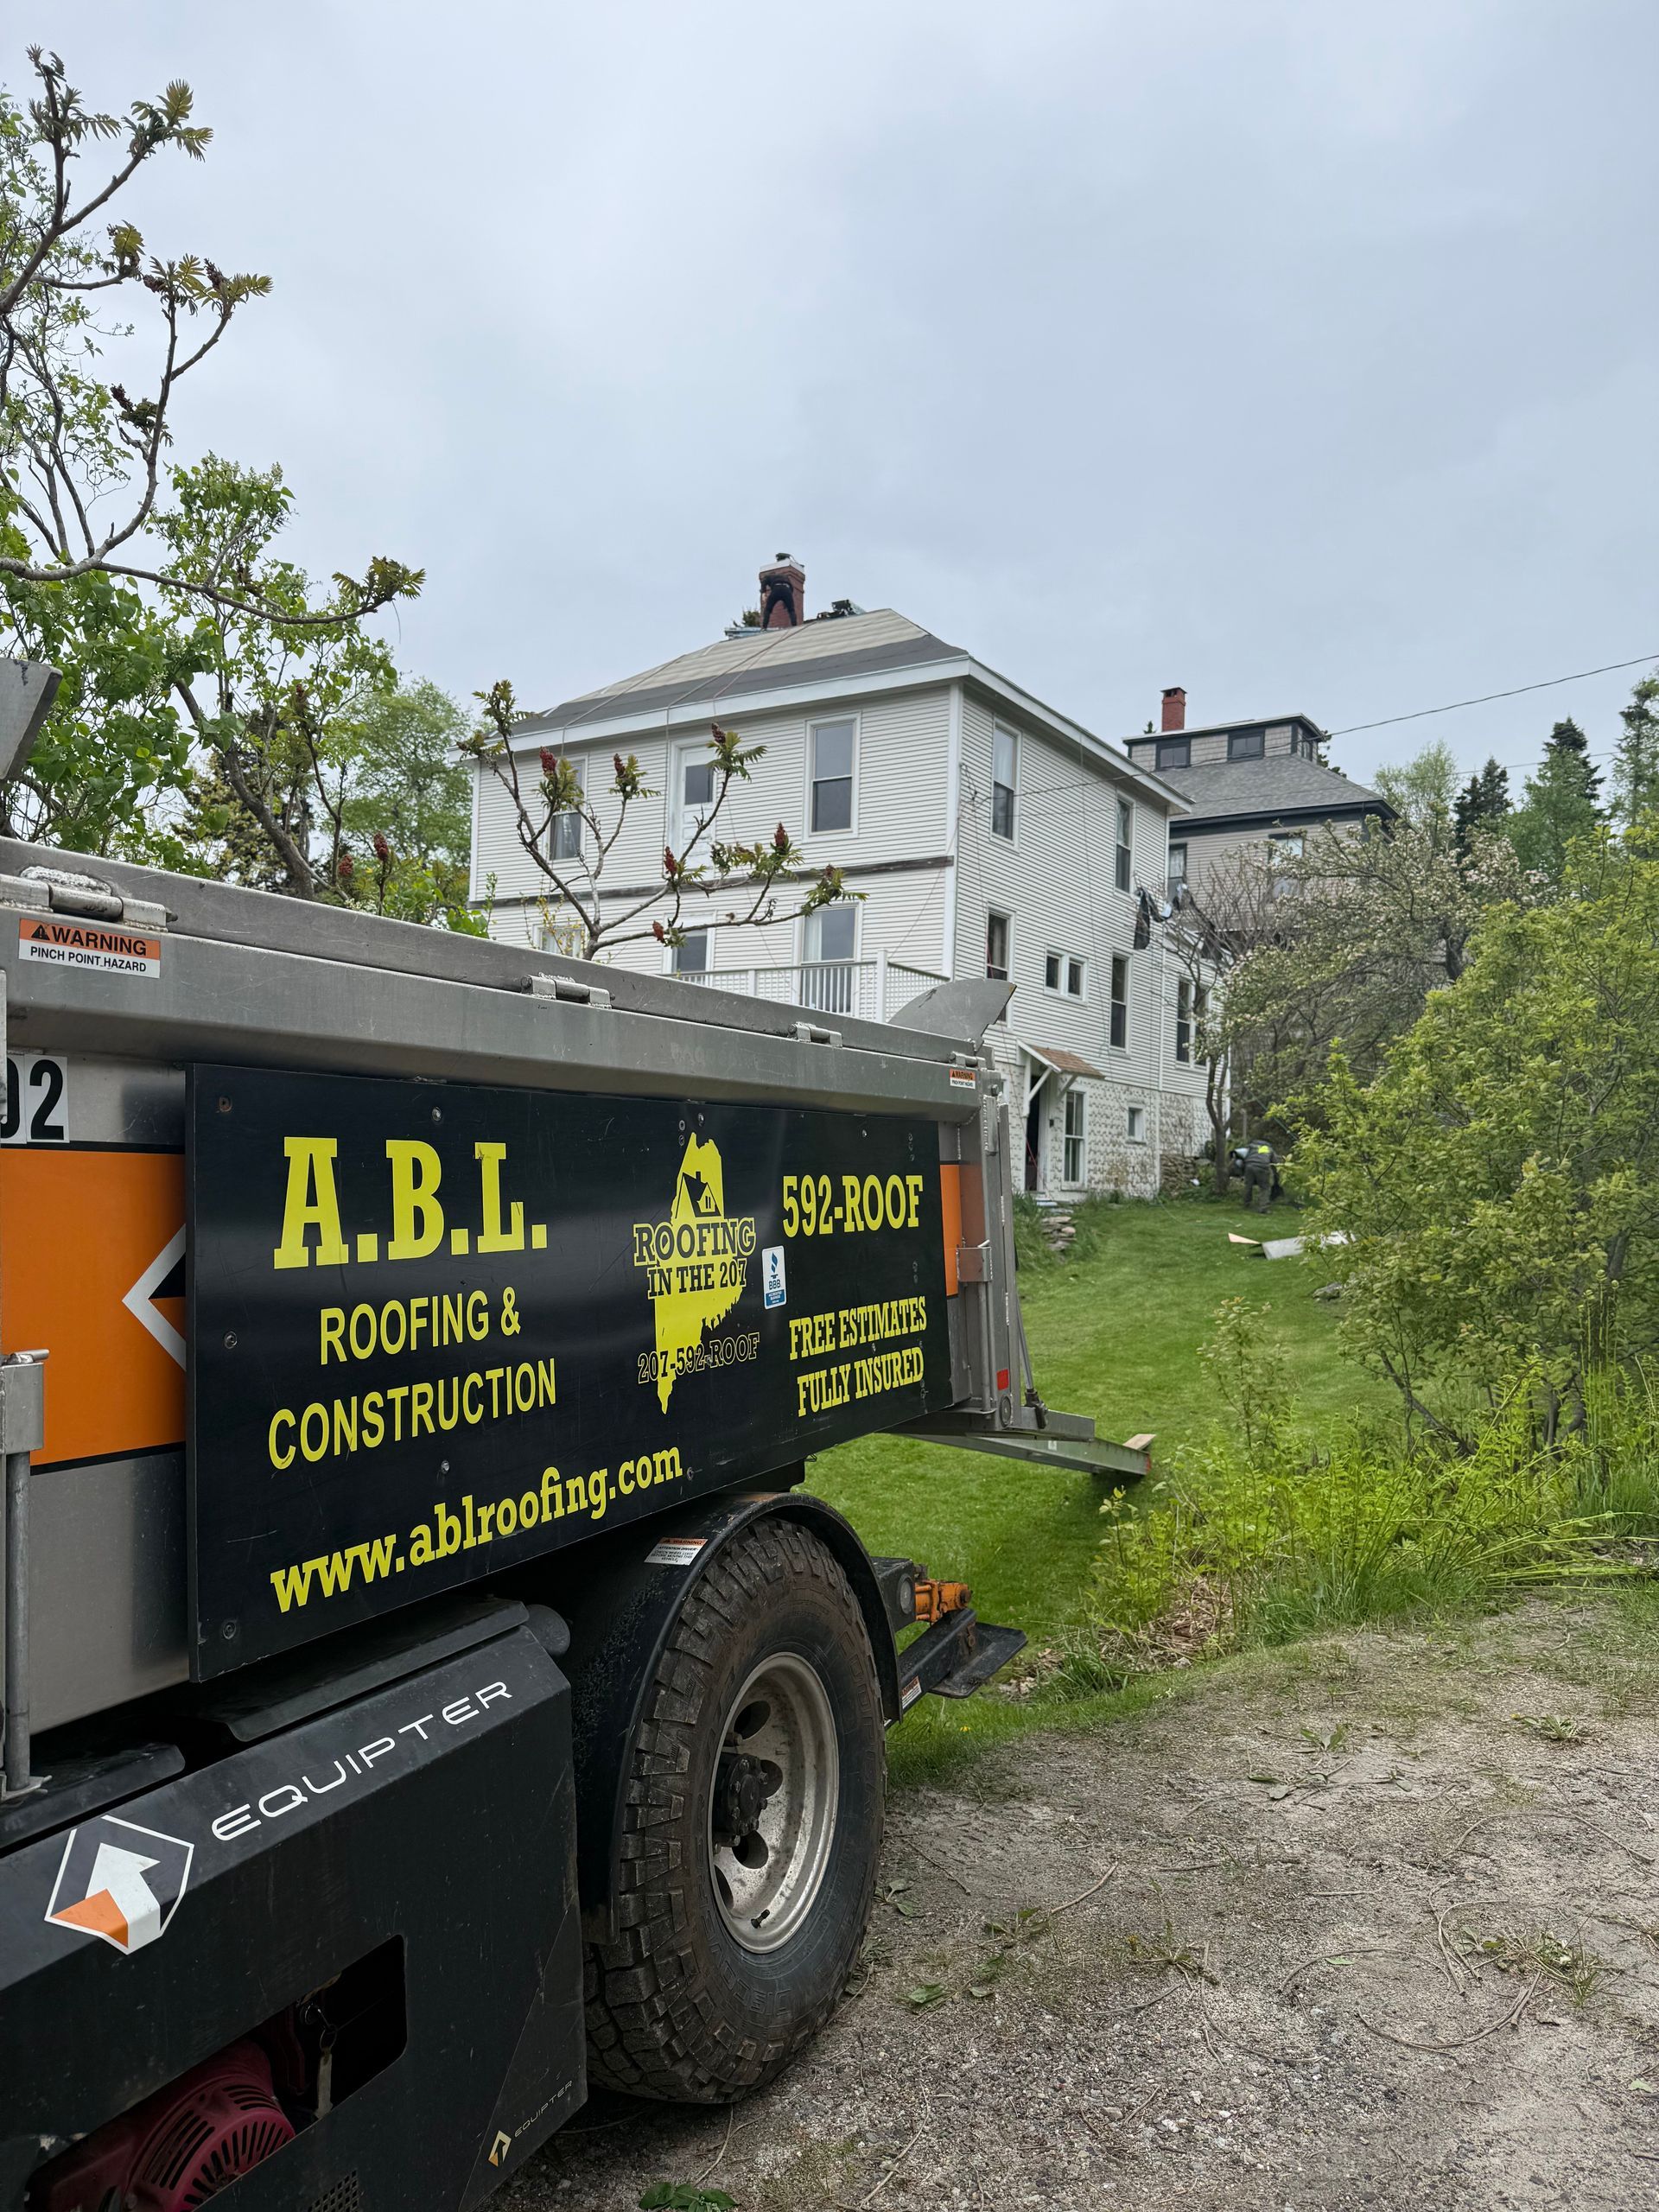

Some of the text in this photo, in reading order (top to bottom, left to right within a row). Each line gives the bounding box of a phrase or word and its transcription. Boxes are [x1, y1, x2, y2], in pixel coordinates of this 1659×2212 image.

[30, 946, 147, 972] PINCH POINT HAZARD
[52, 925, 147, 957] WARNING
[273, 1135, 548, 1269] A.B.L.
[782, 1174, 924, 1238] 592-ROOF
[633, 1217, 757, 1267] ROOFING
[647, 1256, 747, 1300] IN THE 207
[768, 1279, 781, 1290] BBB
[320, 1286, 522, 1365] ROOFING &
[789, 1295, 927, 1361] FREE ESTIMATES
[637, 1332, 760, 1384] 207-592-ROOF
[797, 1345, 925, 1417] FULLY INSURED
[268, 1357, 556, 1470] CONSTRUCTION
[270, 1446, 683, 1613] www.ablroofing.com
[211, 1681, 513, 1841] EQUIPTER
[514, 2080, 573, 2138] EQUIPTER
